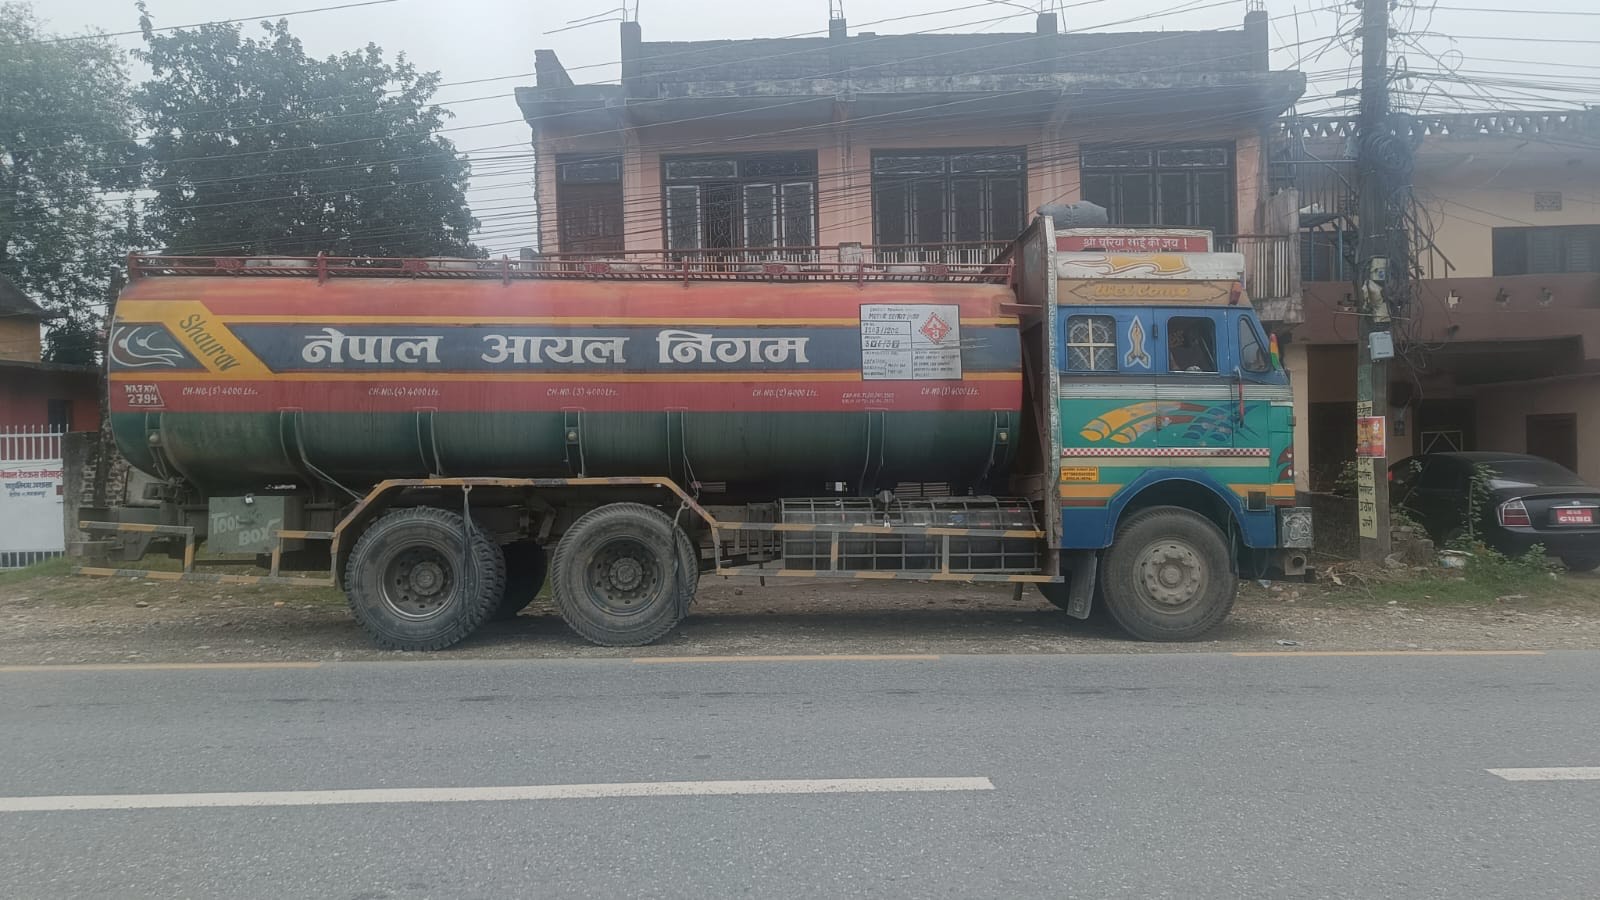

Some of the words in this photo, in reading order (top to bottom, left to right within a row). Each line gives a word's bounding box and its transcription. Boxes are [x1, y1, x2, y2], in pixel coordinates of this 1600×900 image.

[179, 313, 241, 372] Shaurav
[302, 327, 444, 363] नेपाल
[480, 334, 630, 363] आयल
[656, 329, 810, 363] निगम
[128, 394, 158, 404] 2794
[239, 518, 281, 546] BOX
